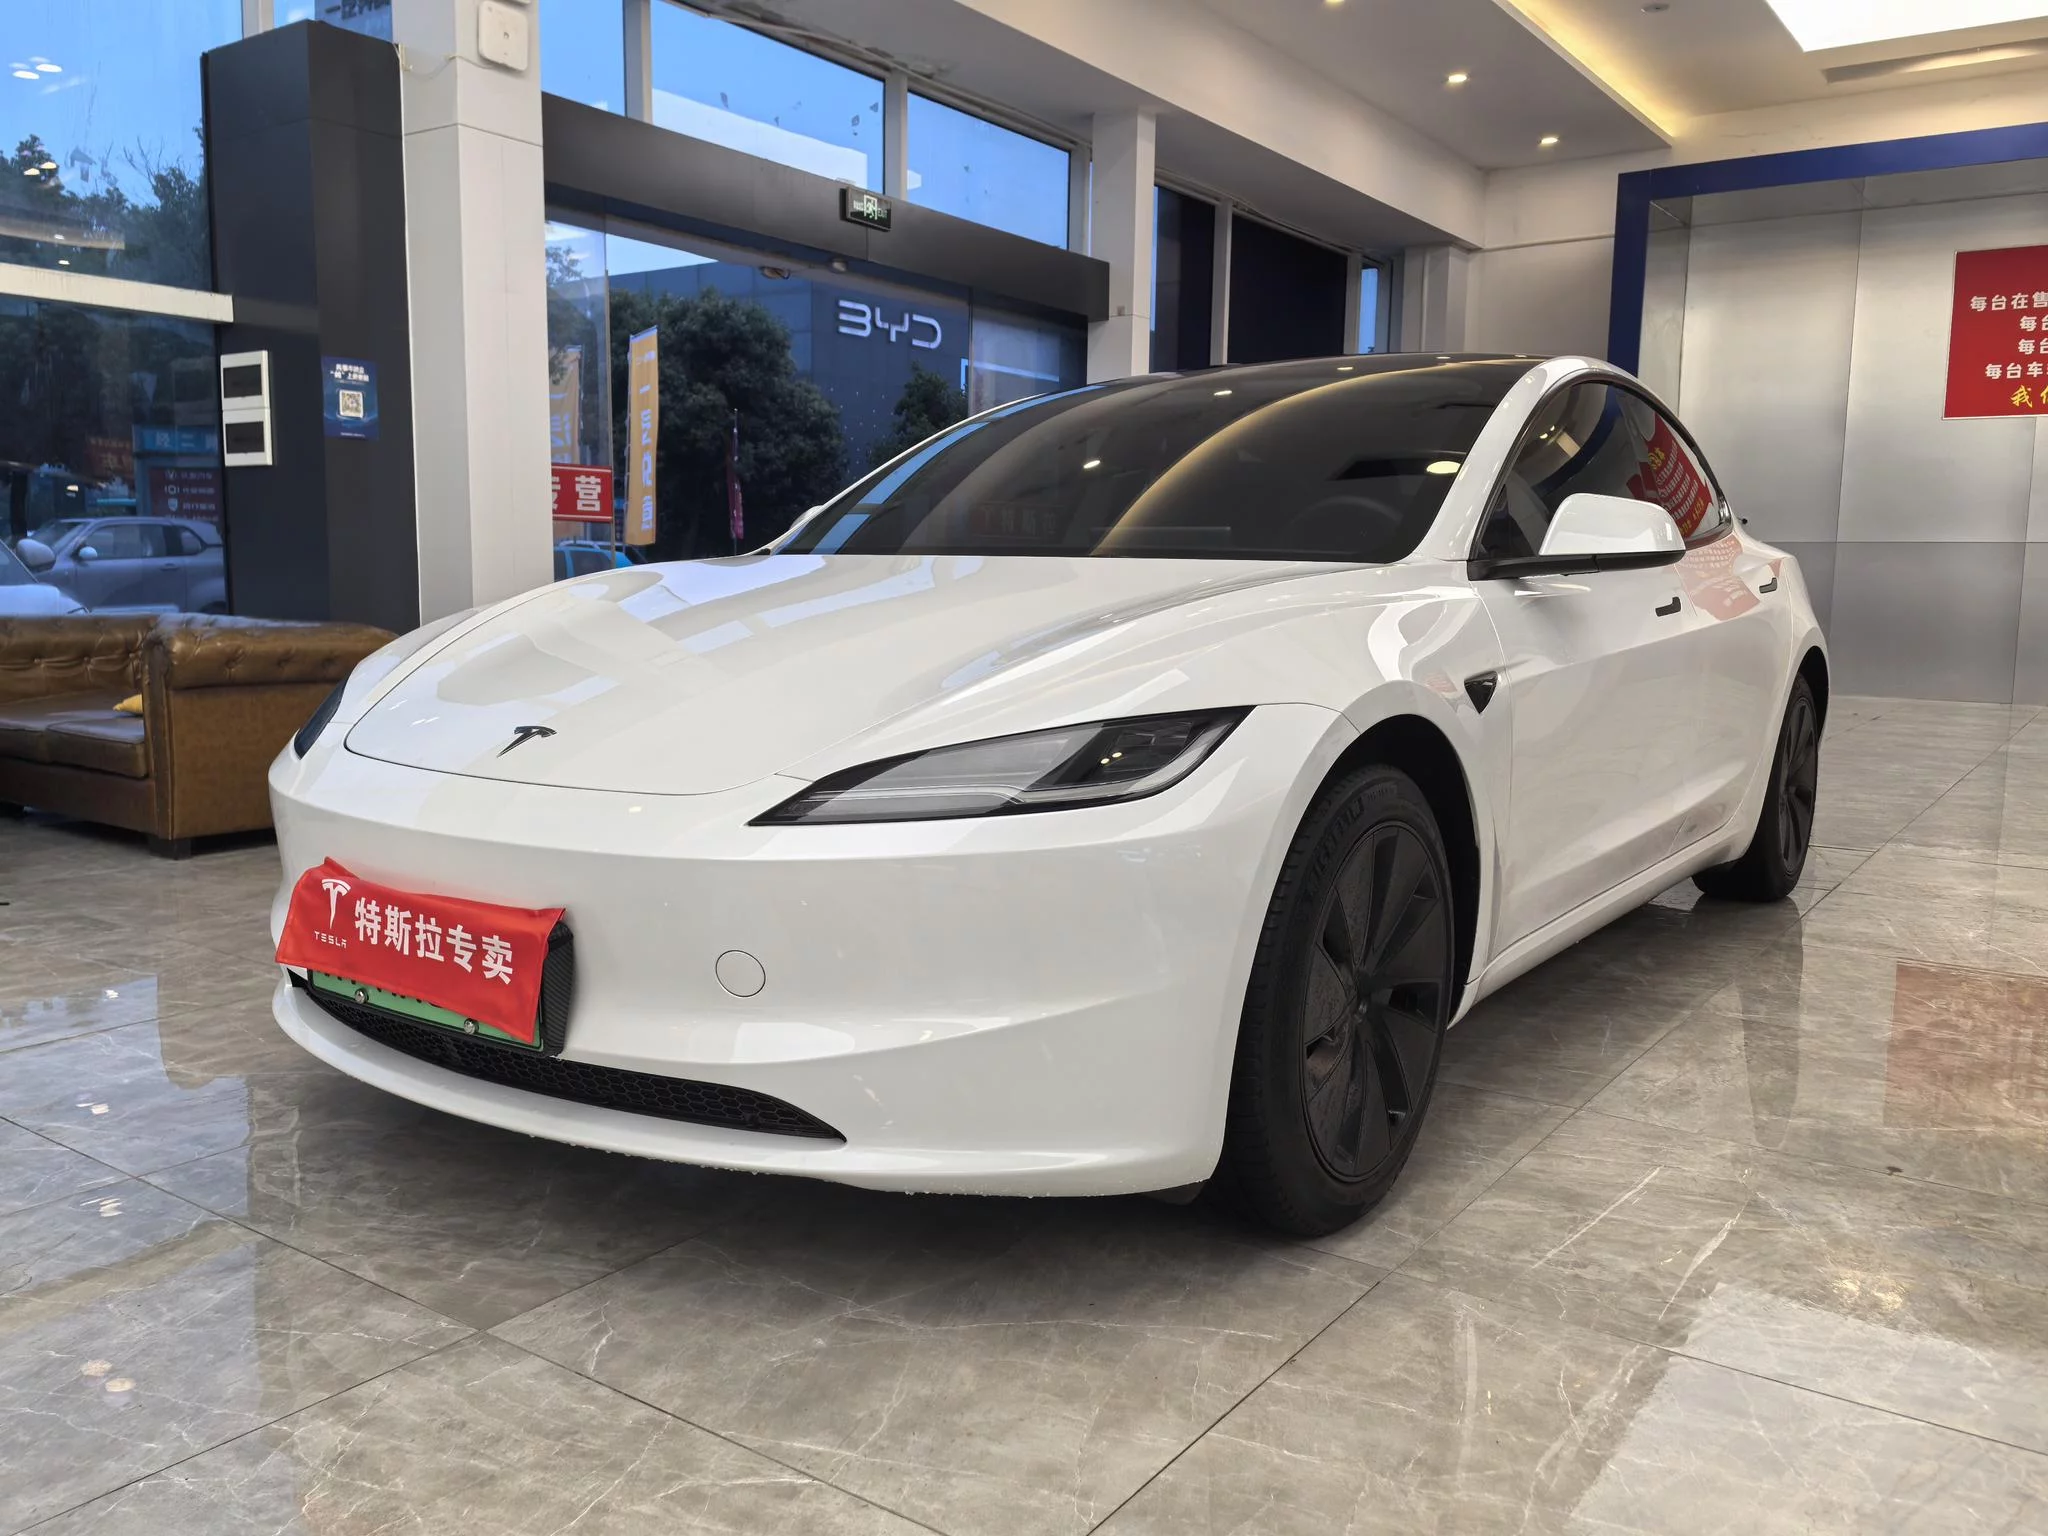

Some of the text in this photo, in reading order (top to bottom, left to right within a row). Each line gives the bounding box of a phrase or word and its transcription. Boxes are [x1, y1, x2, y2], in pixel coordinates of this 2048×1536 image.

[1970, 291, 2048, 312] 每台在售
[838, 299, 942, 349] BYD
[1984, 361, 2048, 379] 每台车
[314, 930, 347, 949] TESLA
[354, 897, 513, 984] 特斯拉专卖
